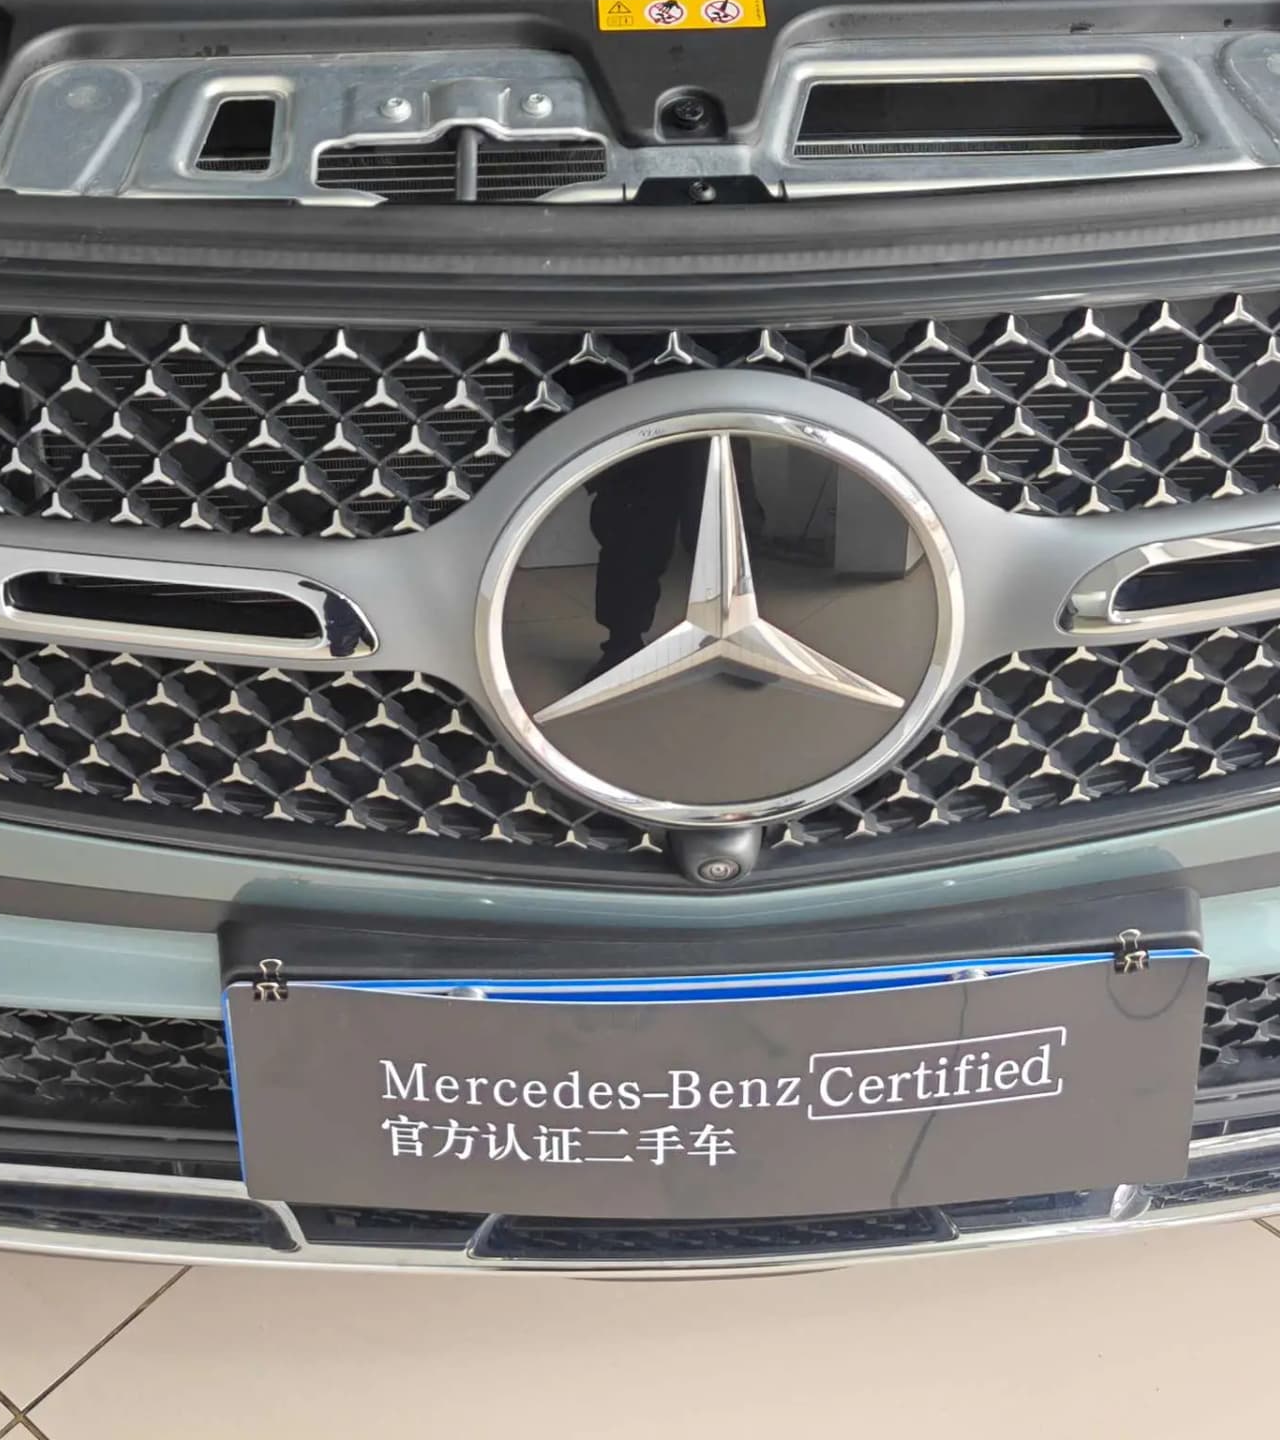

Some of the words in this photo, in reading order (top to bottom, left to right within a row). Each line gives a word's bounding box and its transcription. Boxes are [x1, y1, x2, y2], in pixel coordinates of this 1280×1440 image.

[379, 1059, 801, 1111] Mercedes-Benz
[819, 1043, 1053, 1107] Certified
[380, 1113, 738, 1167] 官方认证二手车
